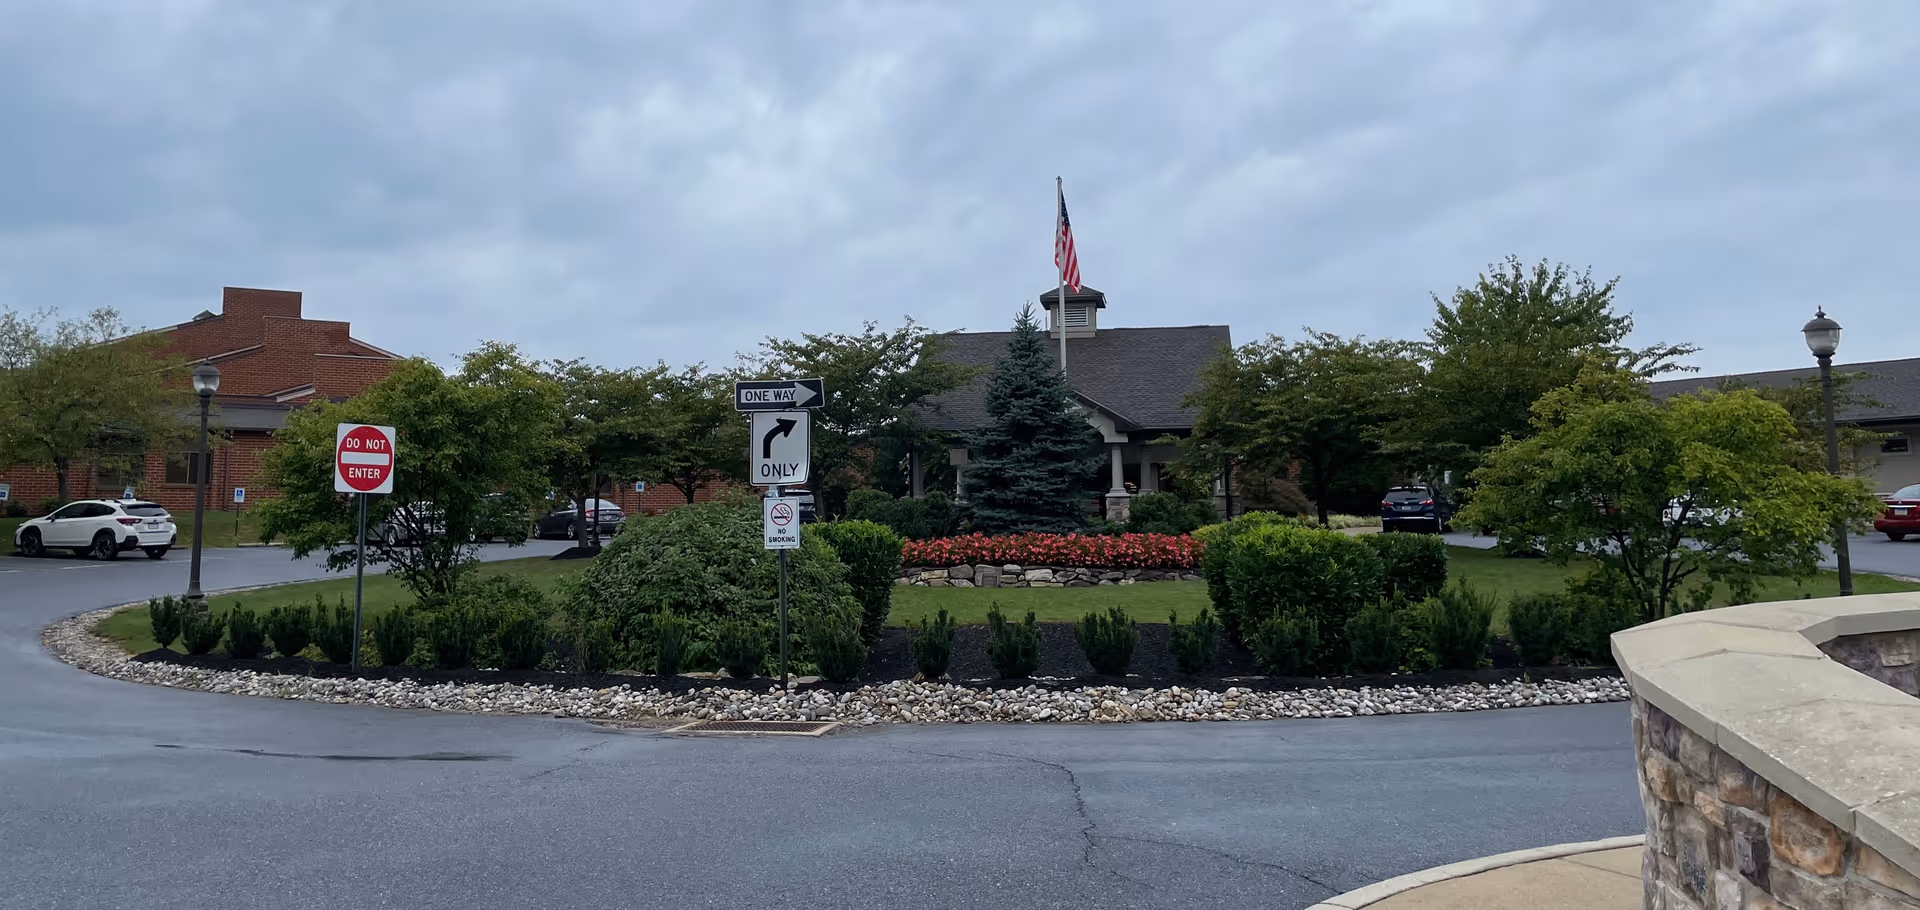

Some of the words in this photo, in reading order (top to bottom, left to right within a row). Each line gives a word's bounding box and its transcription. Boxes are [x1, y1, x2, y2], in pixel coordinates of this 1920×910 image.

[745, 390, 770, 402] ONE
[773, 389, 796, 401] WAY
[346, 437, 360, 449] DO
[365, 438, 386, 450] NOT
[348, 467, 381, 479] ENTER
[761, 463, 799, 477] ONLY
